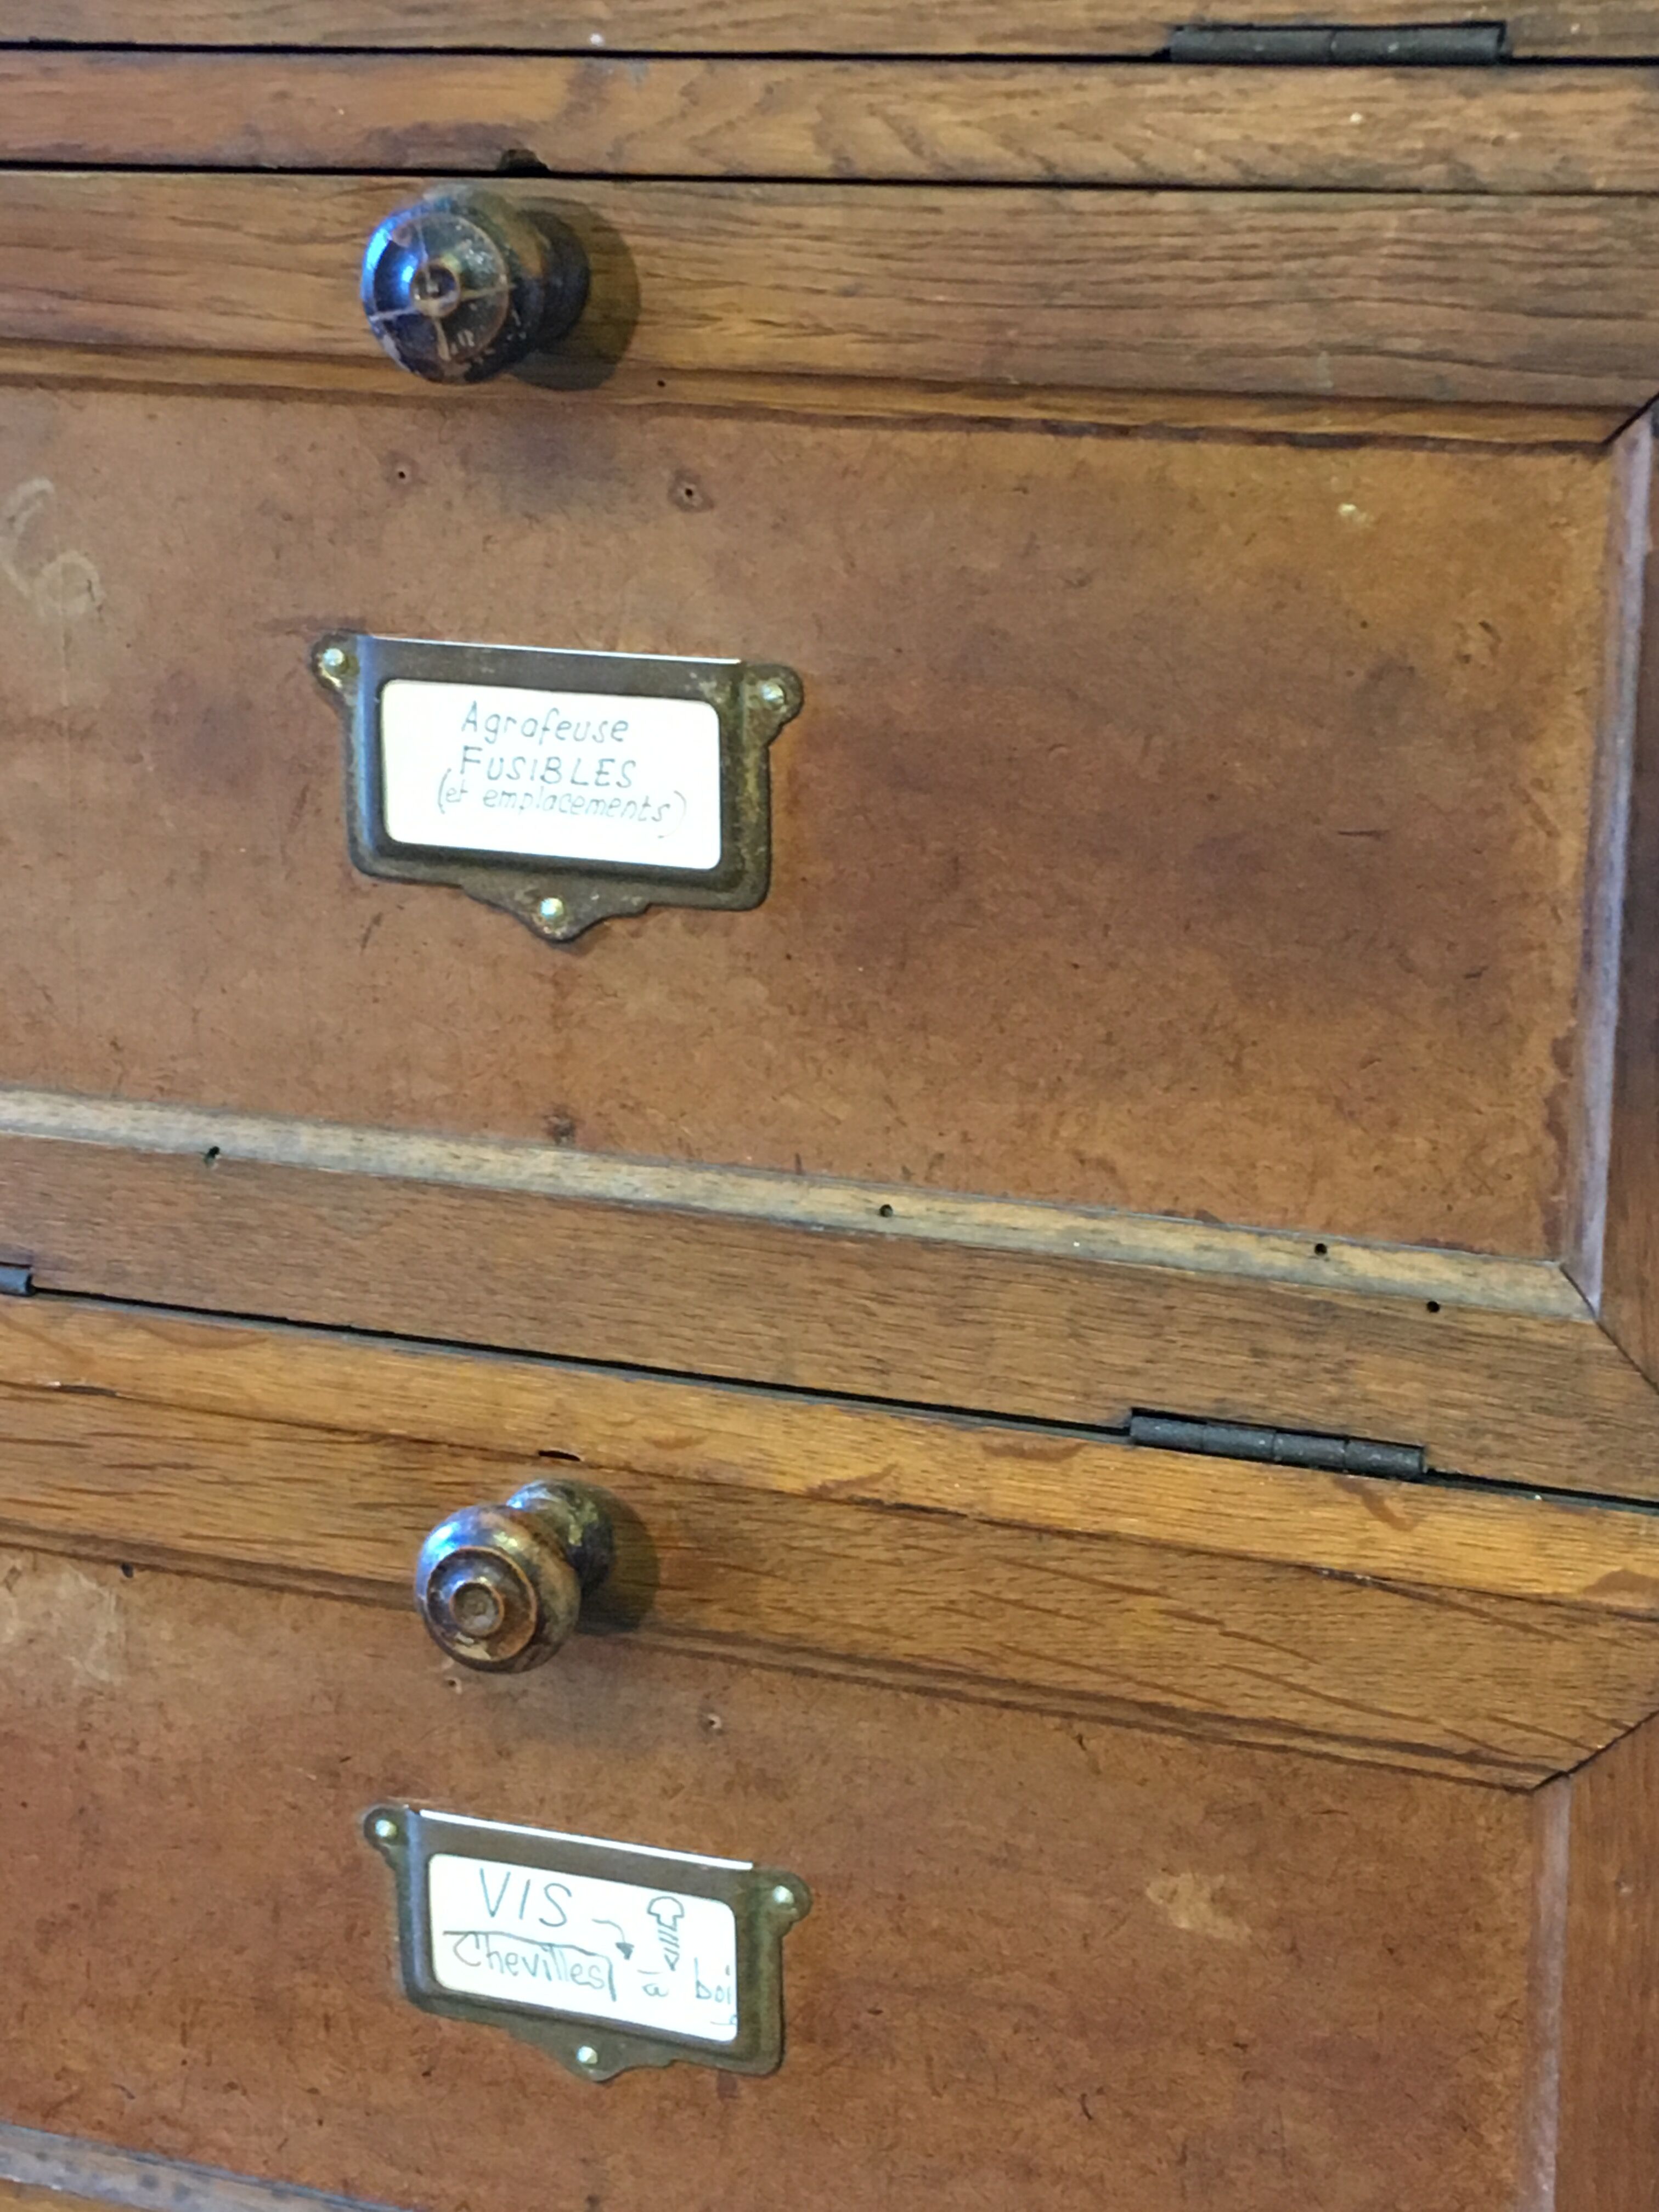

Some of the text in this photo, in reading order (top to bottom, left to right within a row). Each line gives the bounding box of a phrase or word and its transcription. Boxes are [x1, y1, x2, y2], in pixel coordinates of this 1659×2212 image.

[461, 700, 629, 745] Agrafeuse
[460, 744, 637, 789] FUSIBLES
[479, 1867, 572, 1927] VIS
[453, 1931, 605, 1990] Chevilles
